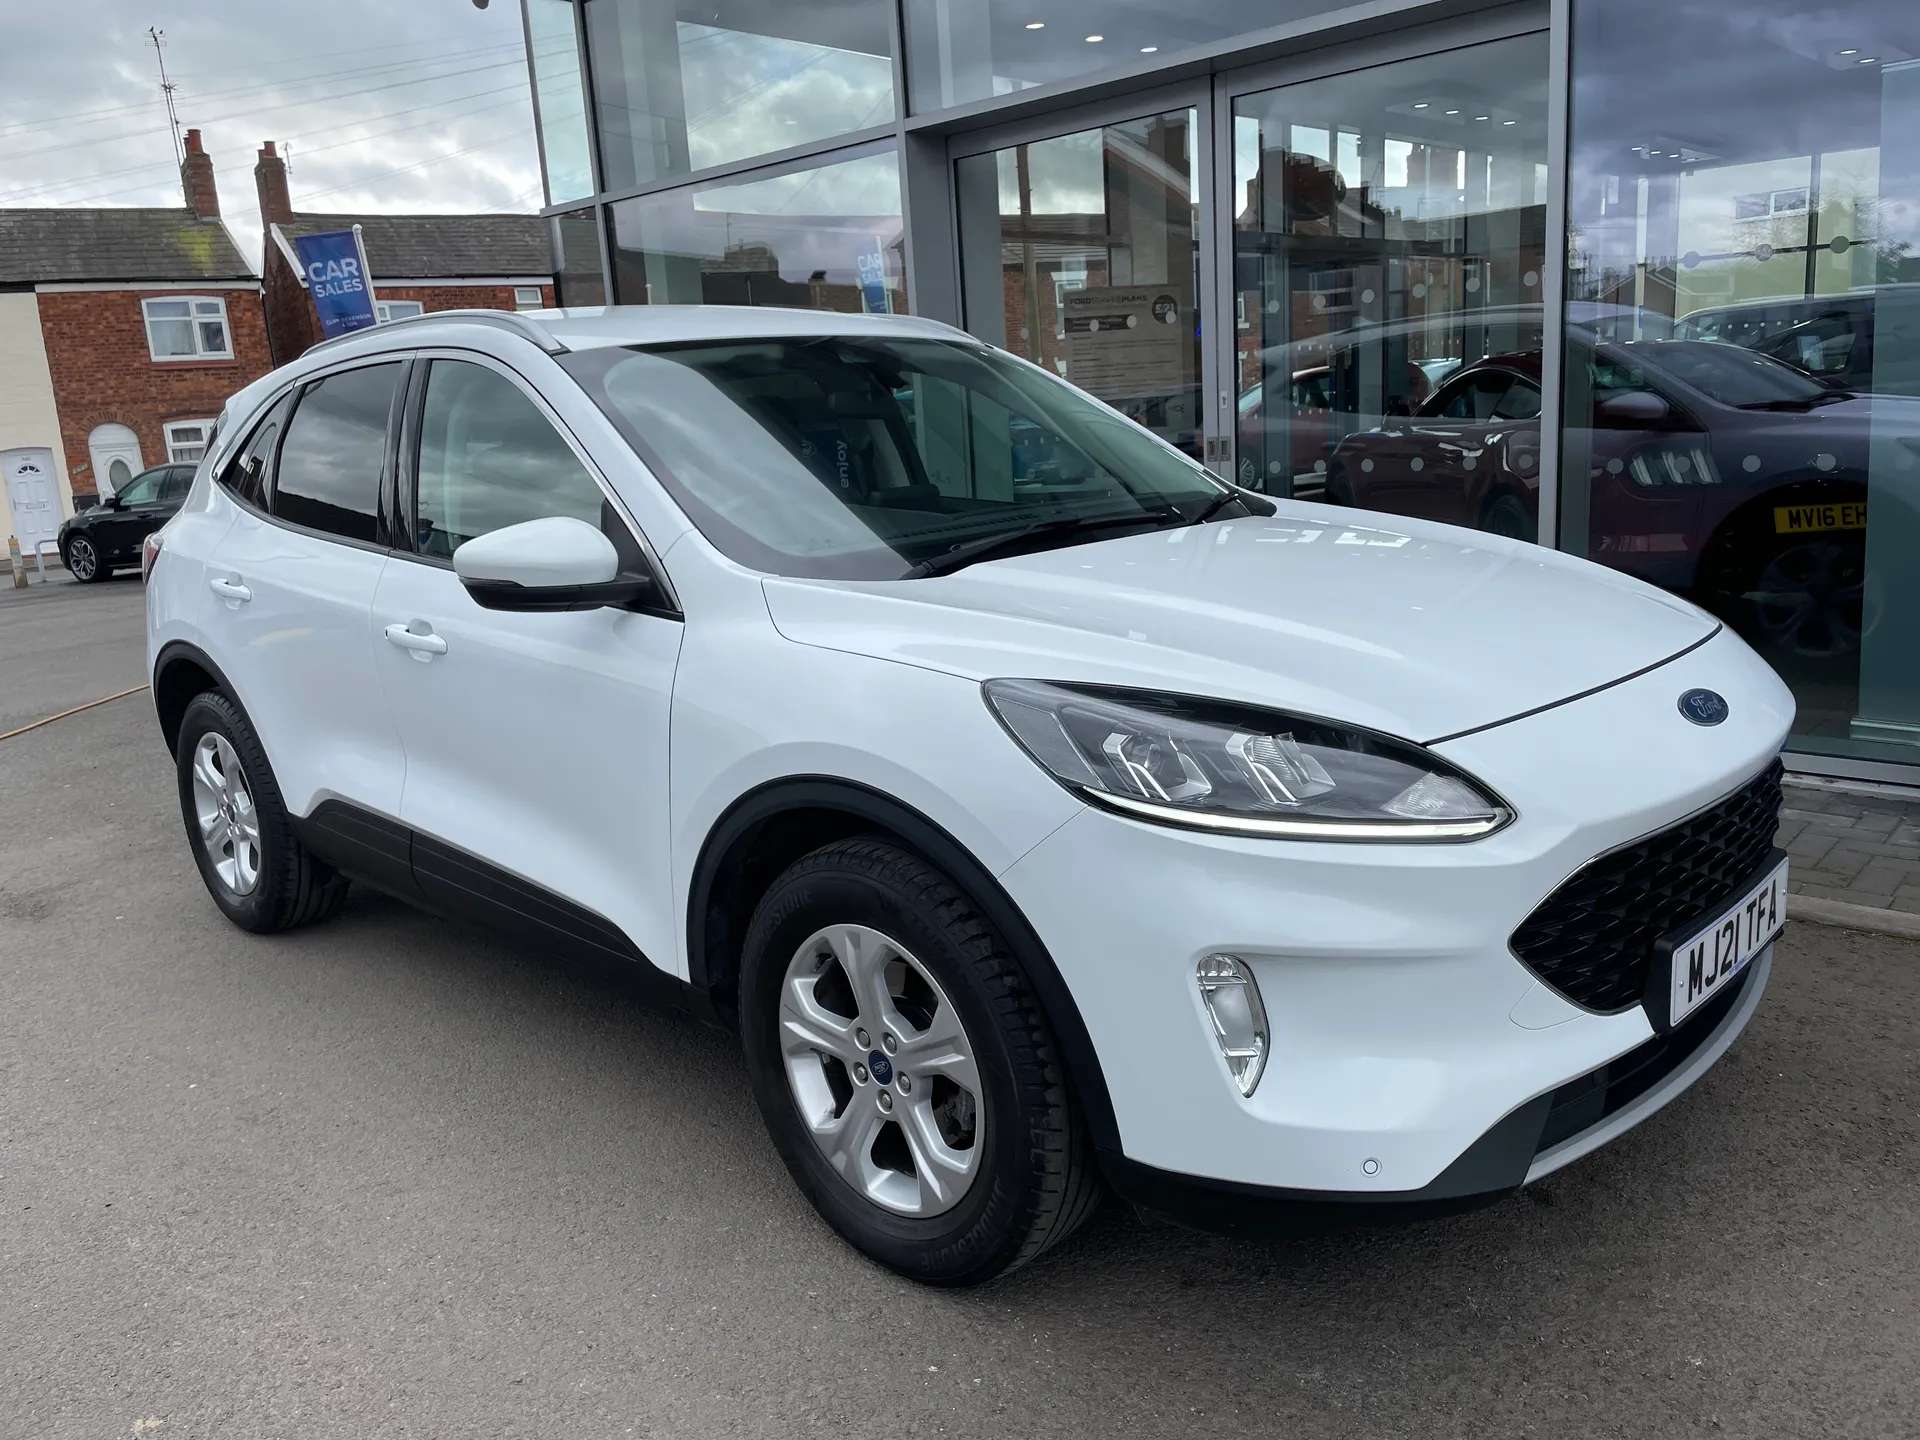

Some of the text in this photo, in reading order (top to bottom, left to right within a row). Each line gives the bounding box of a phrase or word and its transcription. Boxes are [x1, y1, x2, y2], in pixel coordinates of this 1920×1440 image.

[308, 258, 360, 282] CAR
[315, 278, 364, 297] SALES
[837, 440, 849, 489] enjoy
[1787, 507, 1837, 529] MV16
[1687, 879, 1777, 1003] MJ21 TFA
